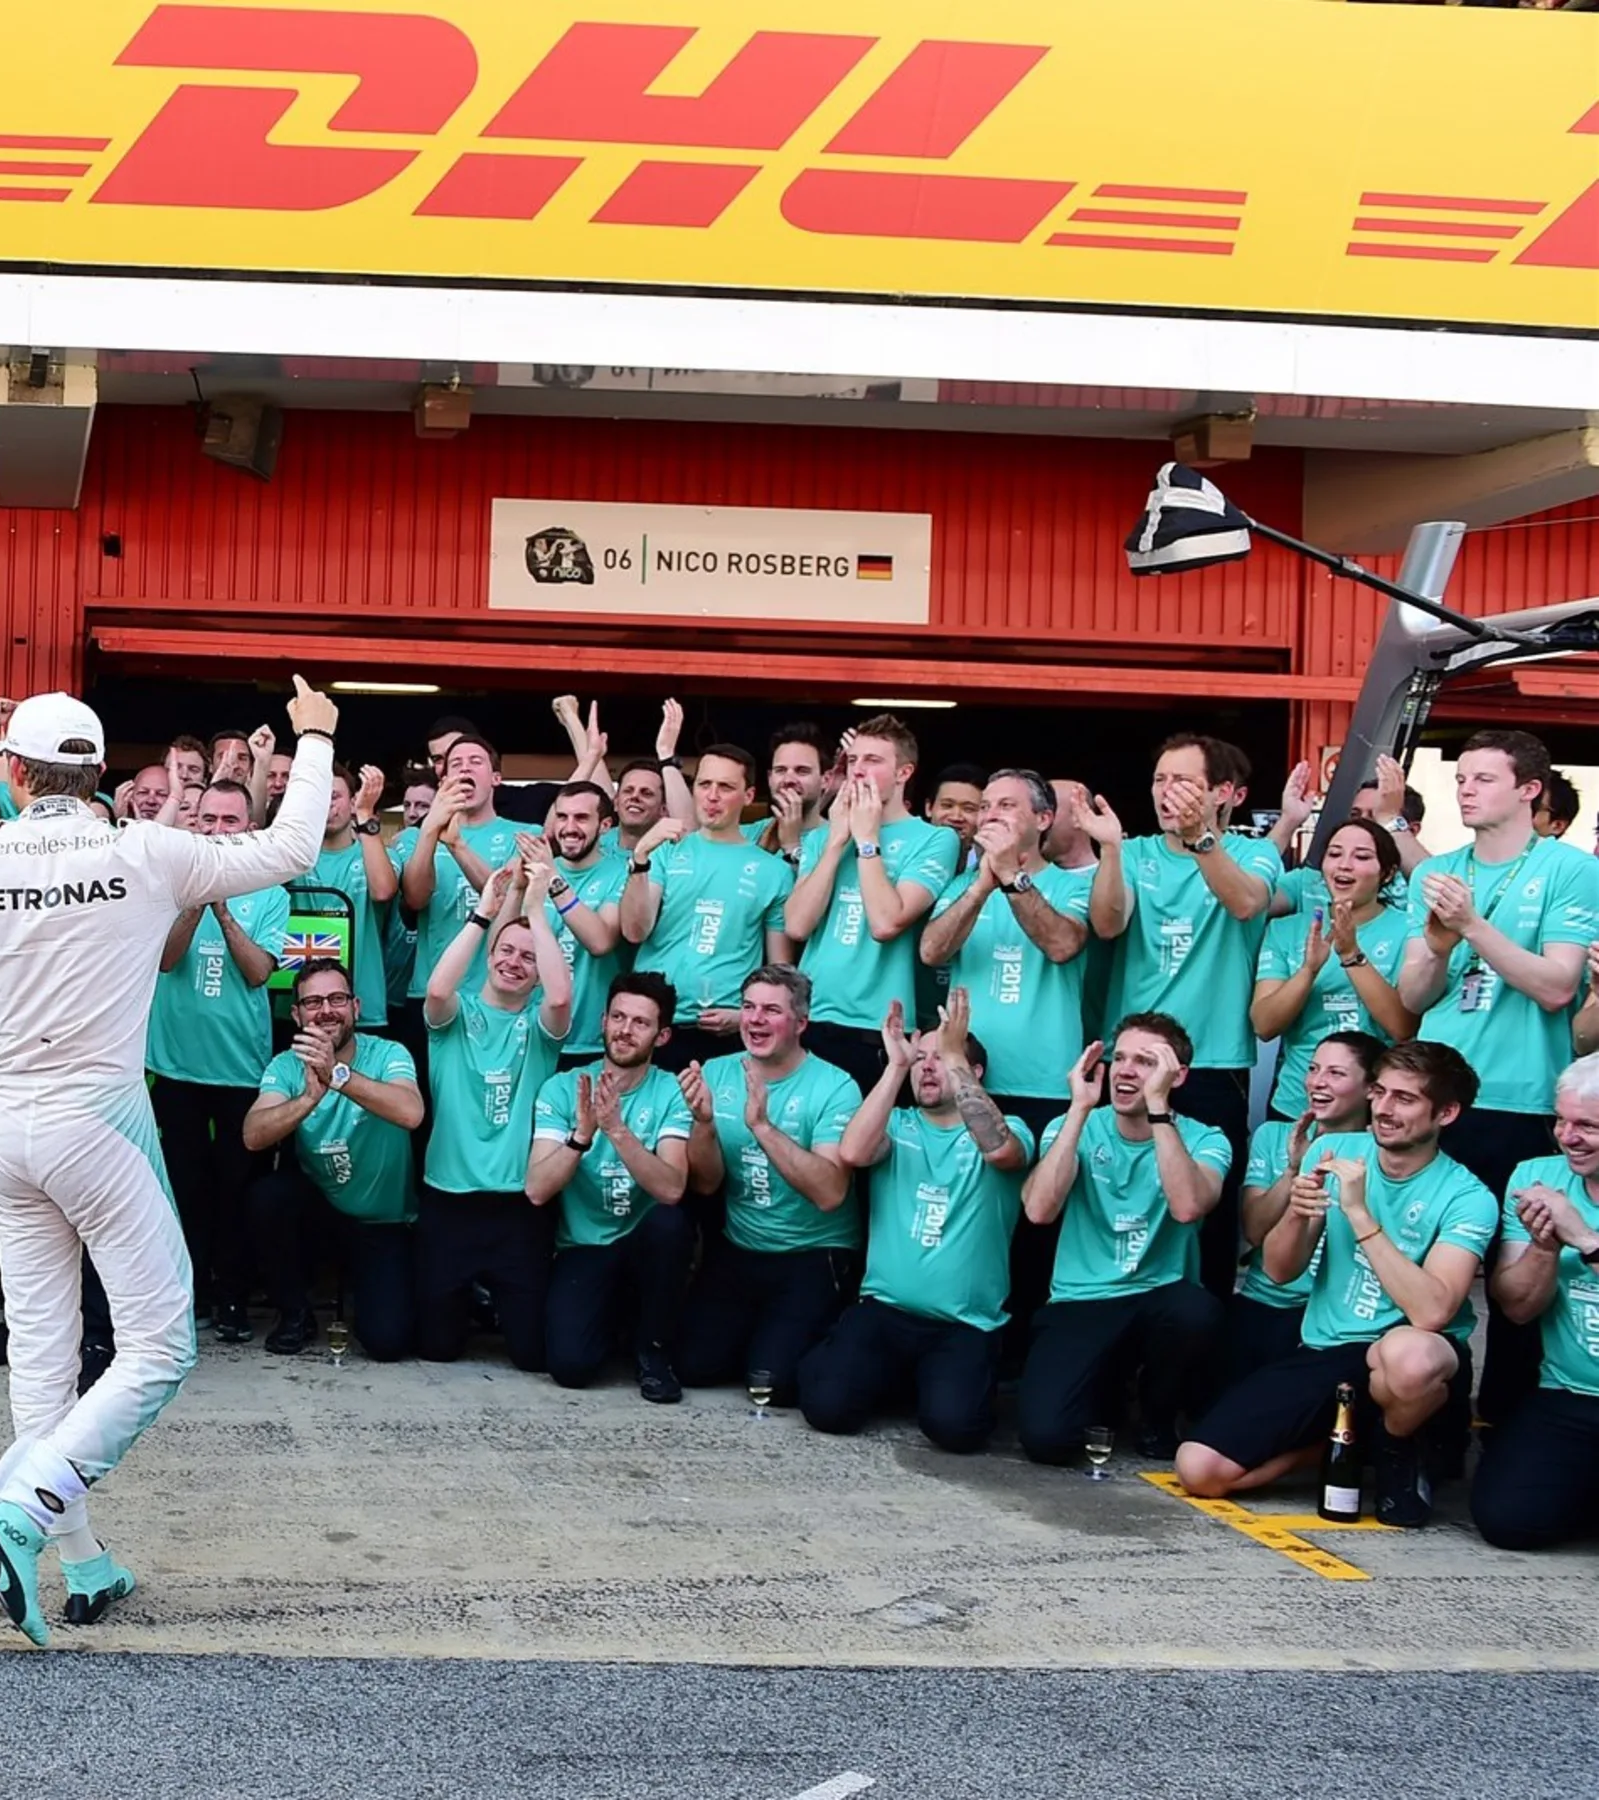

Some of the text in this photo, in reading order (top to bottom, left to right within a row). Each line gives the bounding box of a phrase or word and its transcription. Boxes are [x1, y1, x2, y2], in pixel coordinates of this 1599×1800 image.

[89, 5, 1077, 242] DHL
[604, 548, 850, 578] 06 NICO ROSBERG
[697, 915, 721, 955] 2015
[842, 904, 863, 945] 2015
[204, 957, 224, 998] 2015
[1000, 963, 1022, 1004] 2015
[492, 1085, 512, 1125] 2015
[751, 1166, 771, 1208] 2015
[920, 1203, 949, 1249] 2015
